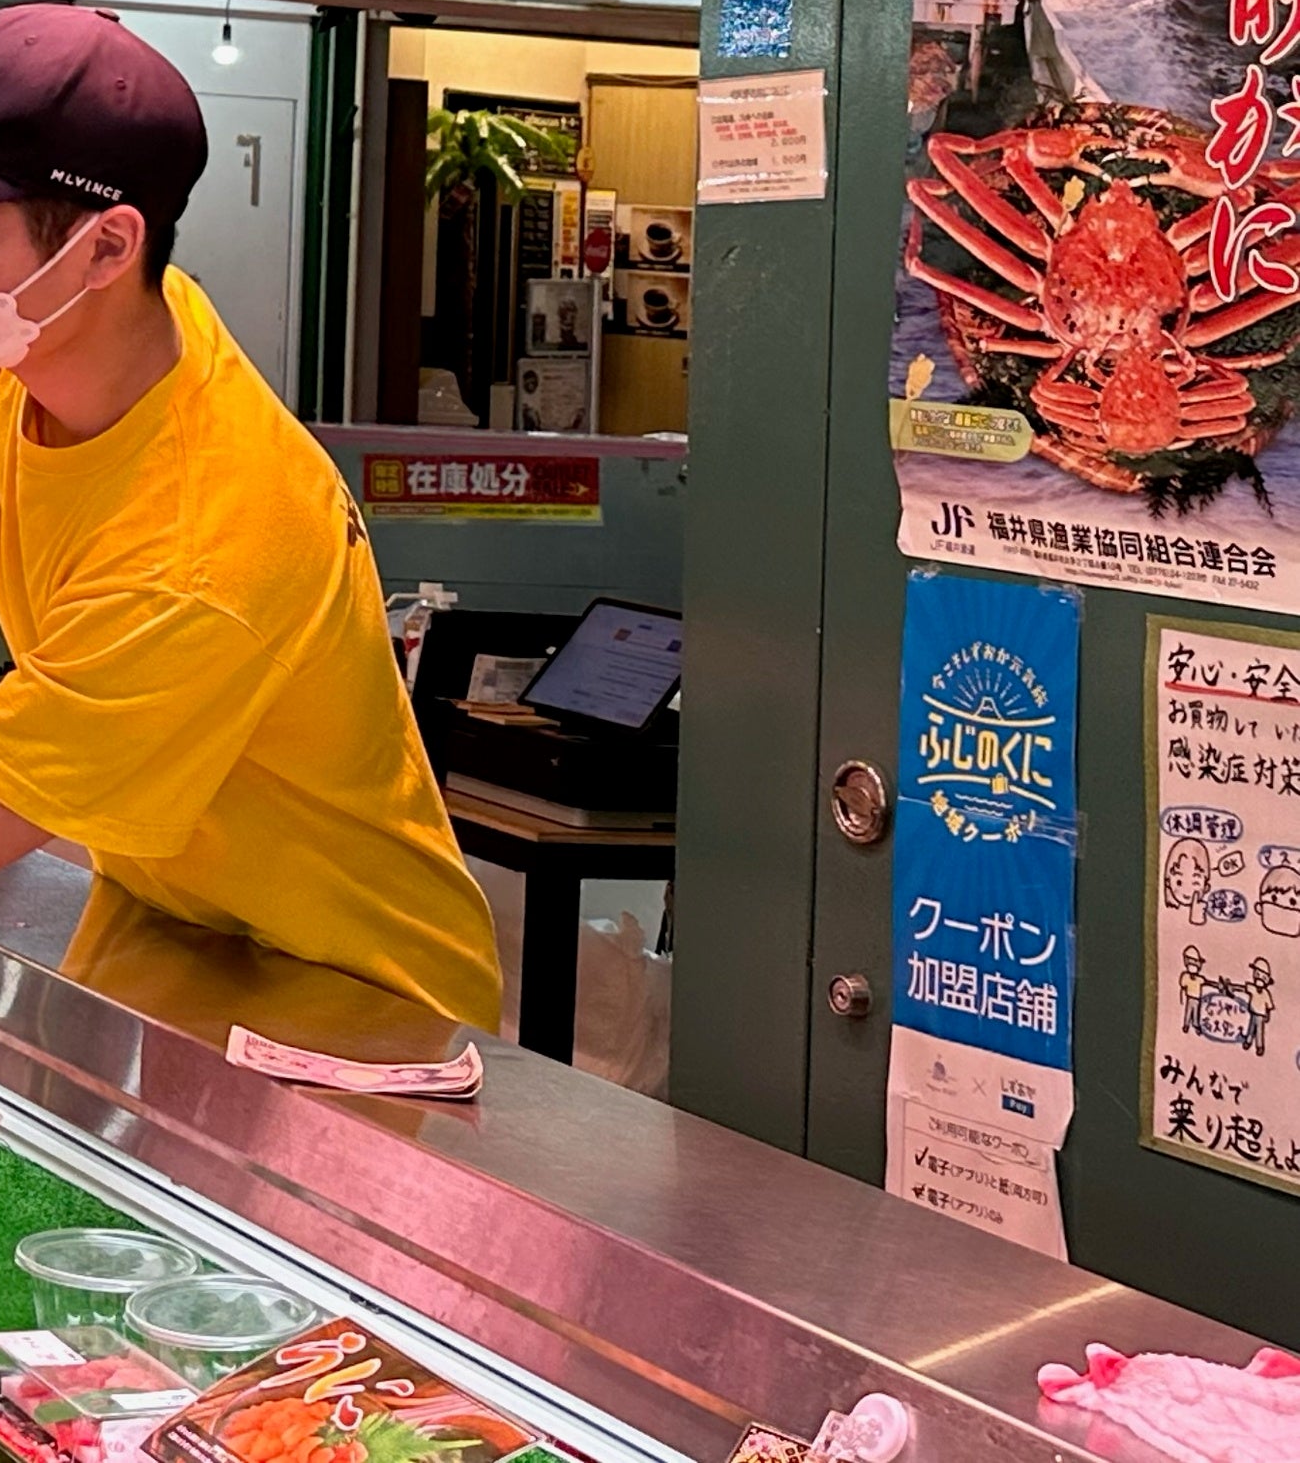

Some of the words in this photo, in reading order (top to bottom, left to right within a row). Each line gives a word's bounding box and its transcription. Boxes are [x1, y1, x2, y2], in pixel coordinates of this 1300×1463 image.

[50, 167, 123, 203] MLVINCE
[407, 461, 530, 497] 在庫処分
[986, 510, 1277, 578] 福井県漁業協同組合連合会
[919, 712, 1052, 787] ふじのくに
[1168, 736, 1300, 796] 感染症対策
[1166, 812, 1238, 839] 体調管理
[1222, 856, 1239, 871] OK
[909, 897, 1057, 966] クーポン
[907, 951, 1058, 1034] 加盟店舗
[1160, 1055, 1249, 1105] みんなで
